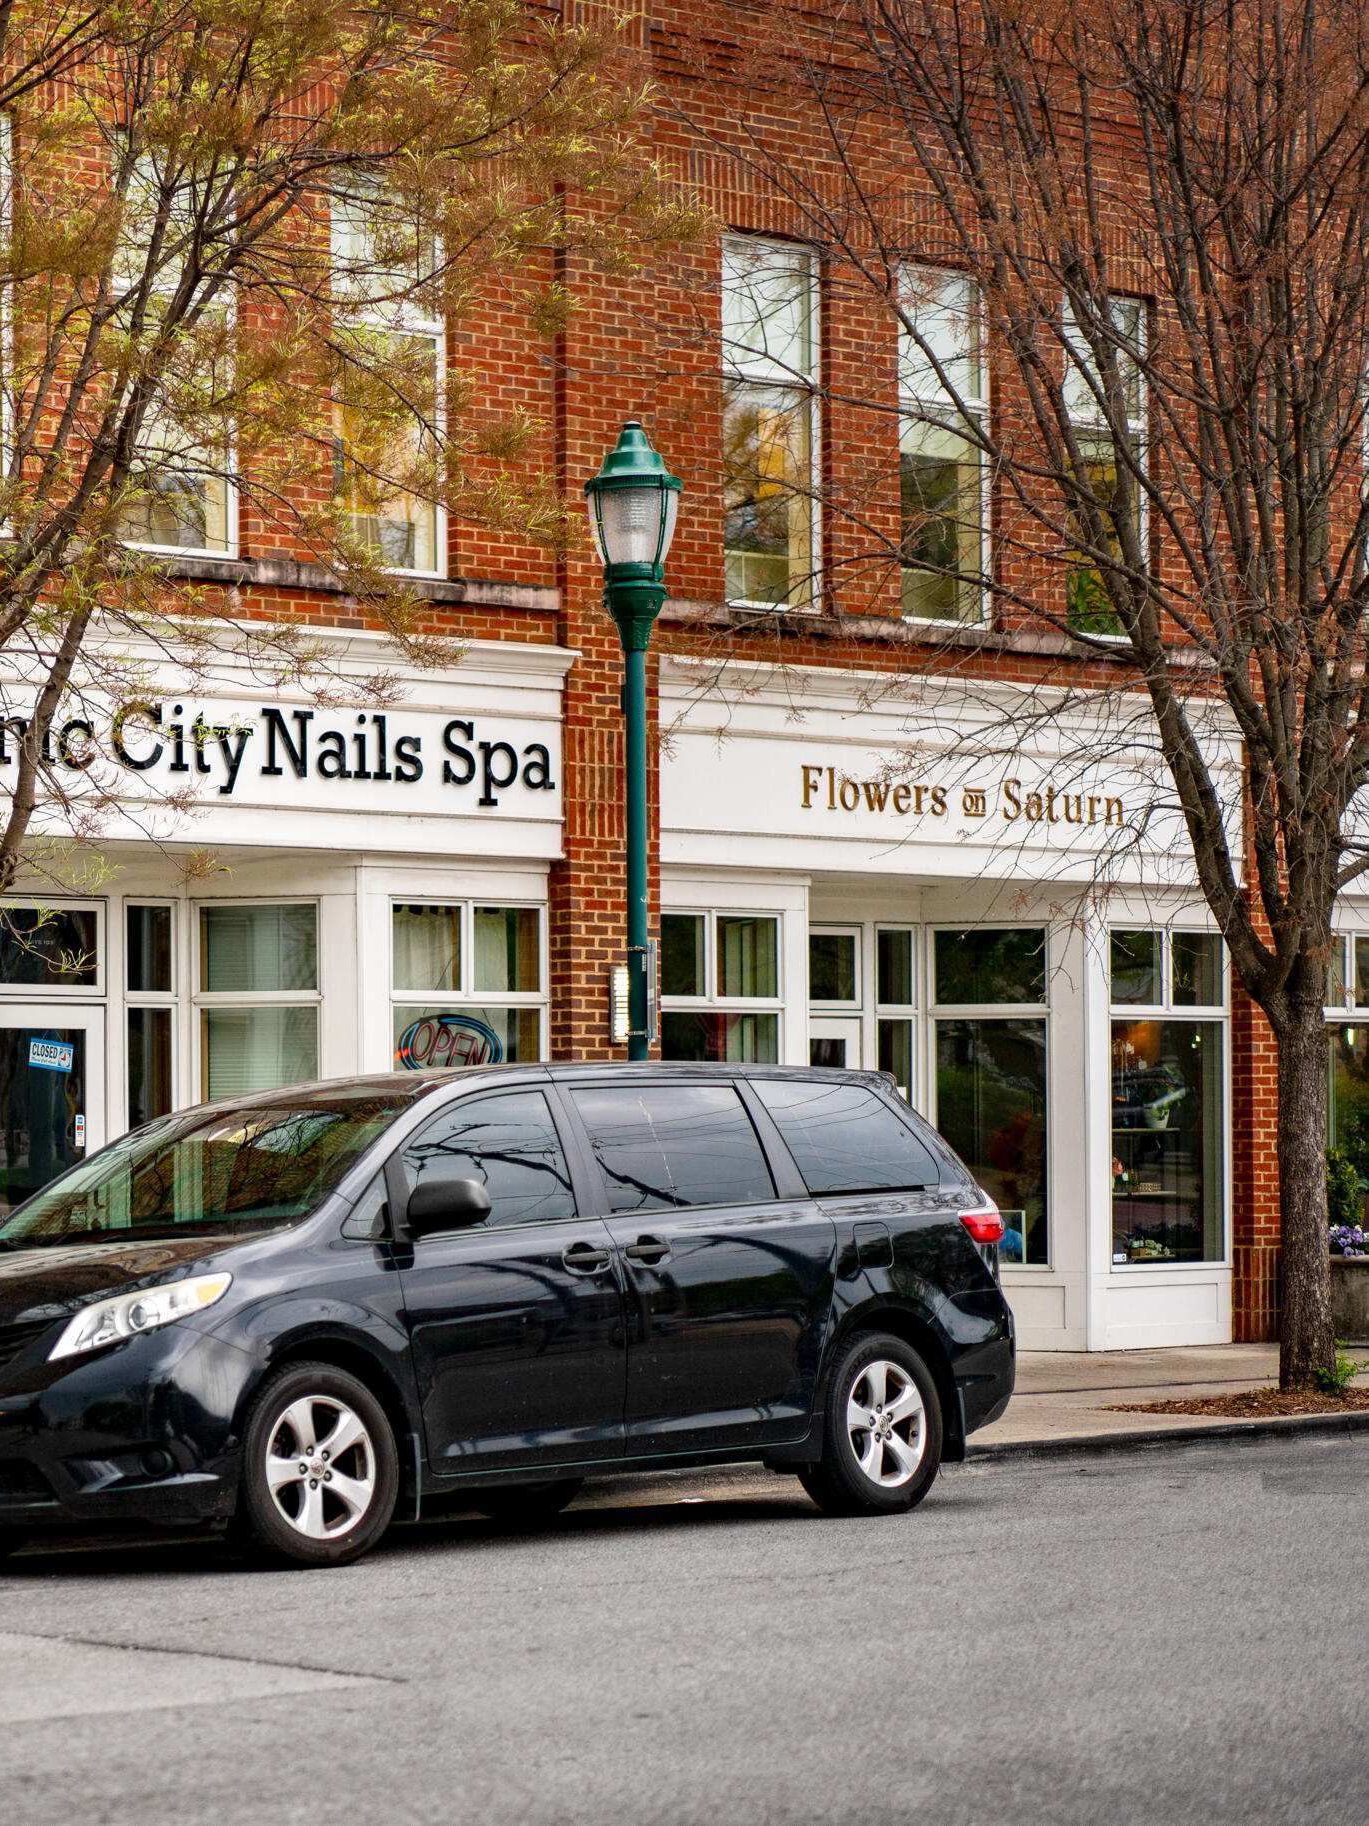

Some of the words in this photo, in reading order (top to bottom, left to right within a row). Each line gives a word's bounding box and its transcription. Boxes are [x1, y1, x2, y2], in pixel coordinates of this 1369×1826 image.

[113, 702, 253, 793] City
[261, 708, 423, 782] Nails
[443, 719, 555, 806] Spa
[800, 765, 948, 816] Flowers
[962, 790, 986, 815] on
[1002, 777, 1124, 826] Saturn
[32, 1043, 58, 1059] CLOSED
[413, 1022, 490, 1067] OPEN
